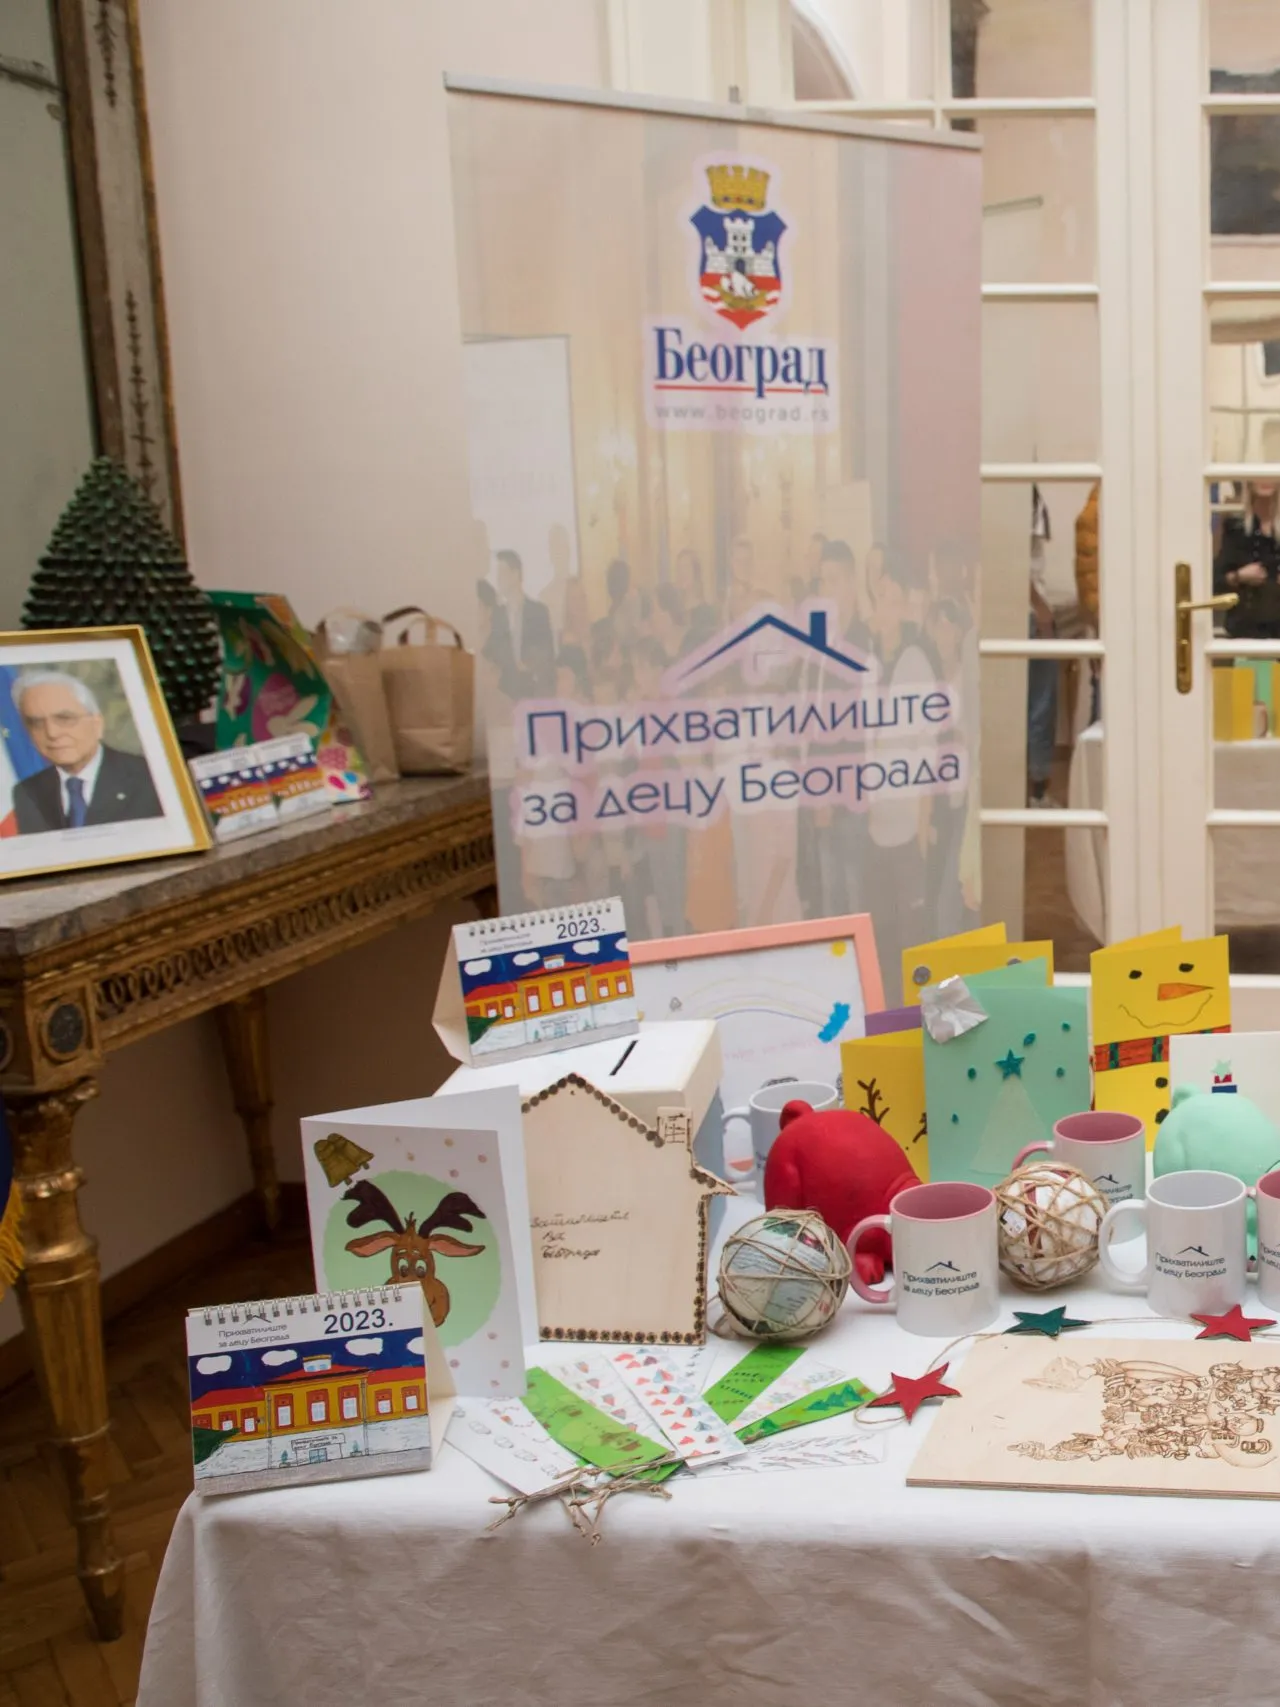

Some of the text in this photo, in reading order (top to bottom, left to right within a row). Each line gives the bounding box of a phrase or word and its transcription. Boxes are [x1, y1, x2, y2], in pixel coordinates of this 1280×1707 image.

[653, 326, 829, 398] Београд
[655, 405, 830, 424] www.beograd.rs
[526, 691, 951, 763] Прихватилиште
[523, 753, 961, 826] за децу Београда
[556, 917, 606, 940] 2023.
[1155, 1251, 1225, 1267] Прихватилиште
[902, 1271, 977, 1284] Прихватилиште
[1184, 1267, 1227, 1278] Београда
[935, 1282, 980, 1295] Београда
[323, 1309, 394, 1334] 2023.
[218, 1323, 288, 1339] Прихватилиште
[229, 1338, 250, 1347] децу
[250, 1333, 290, 1345] Београда
